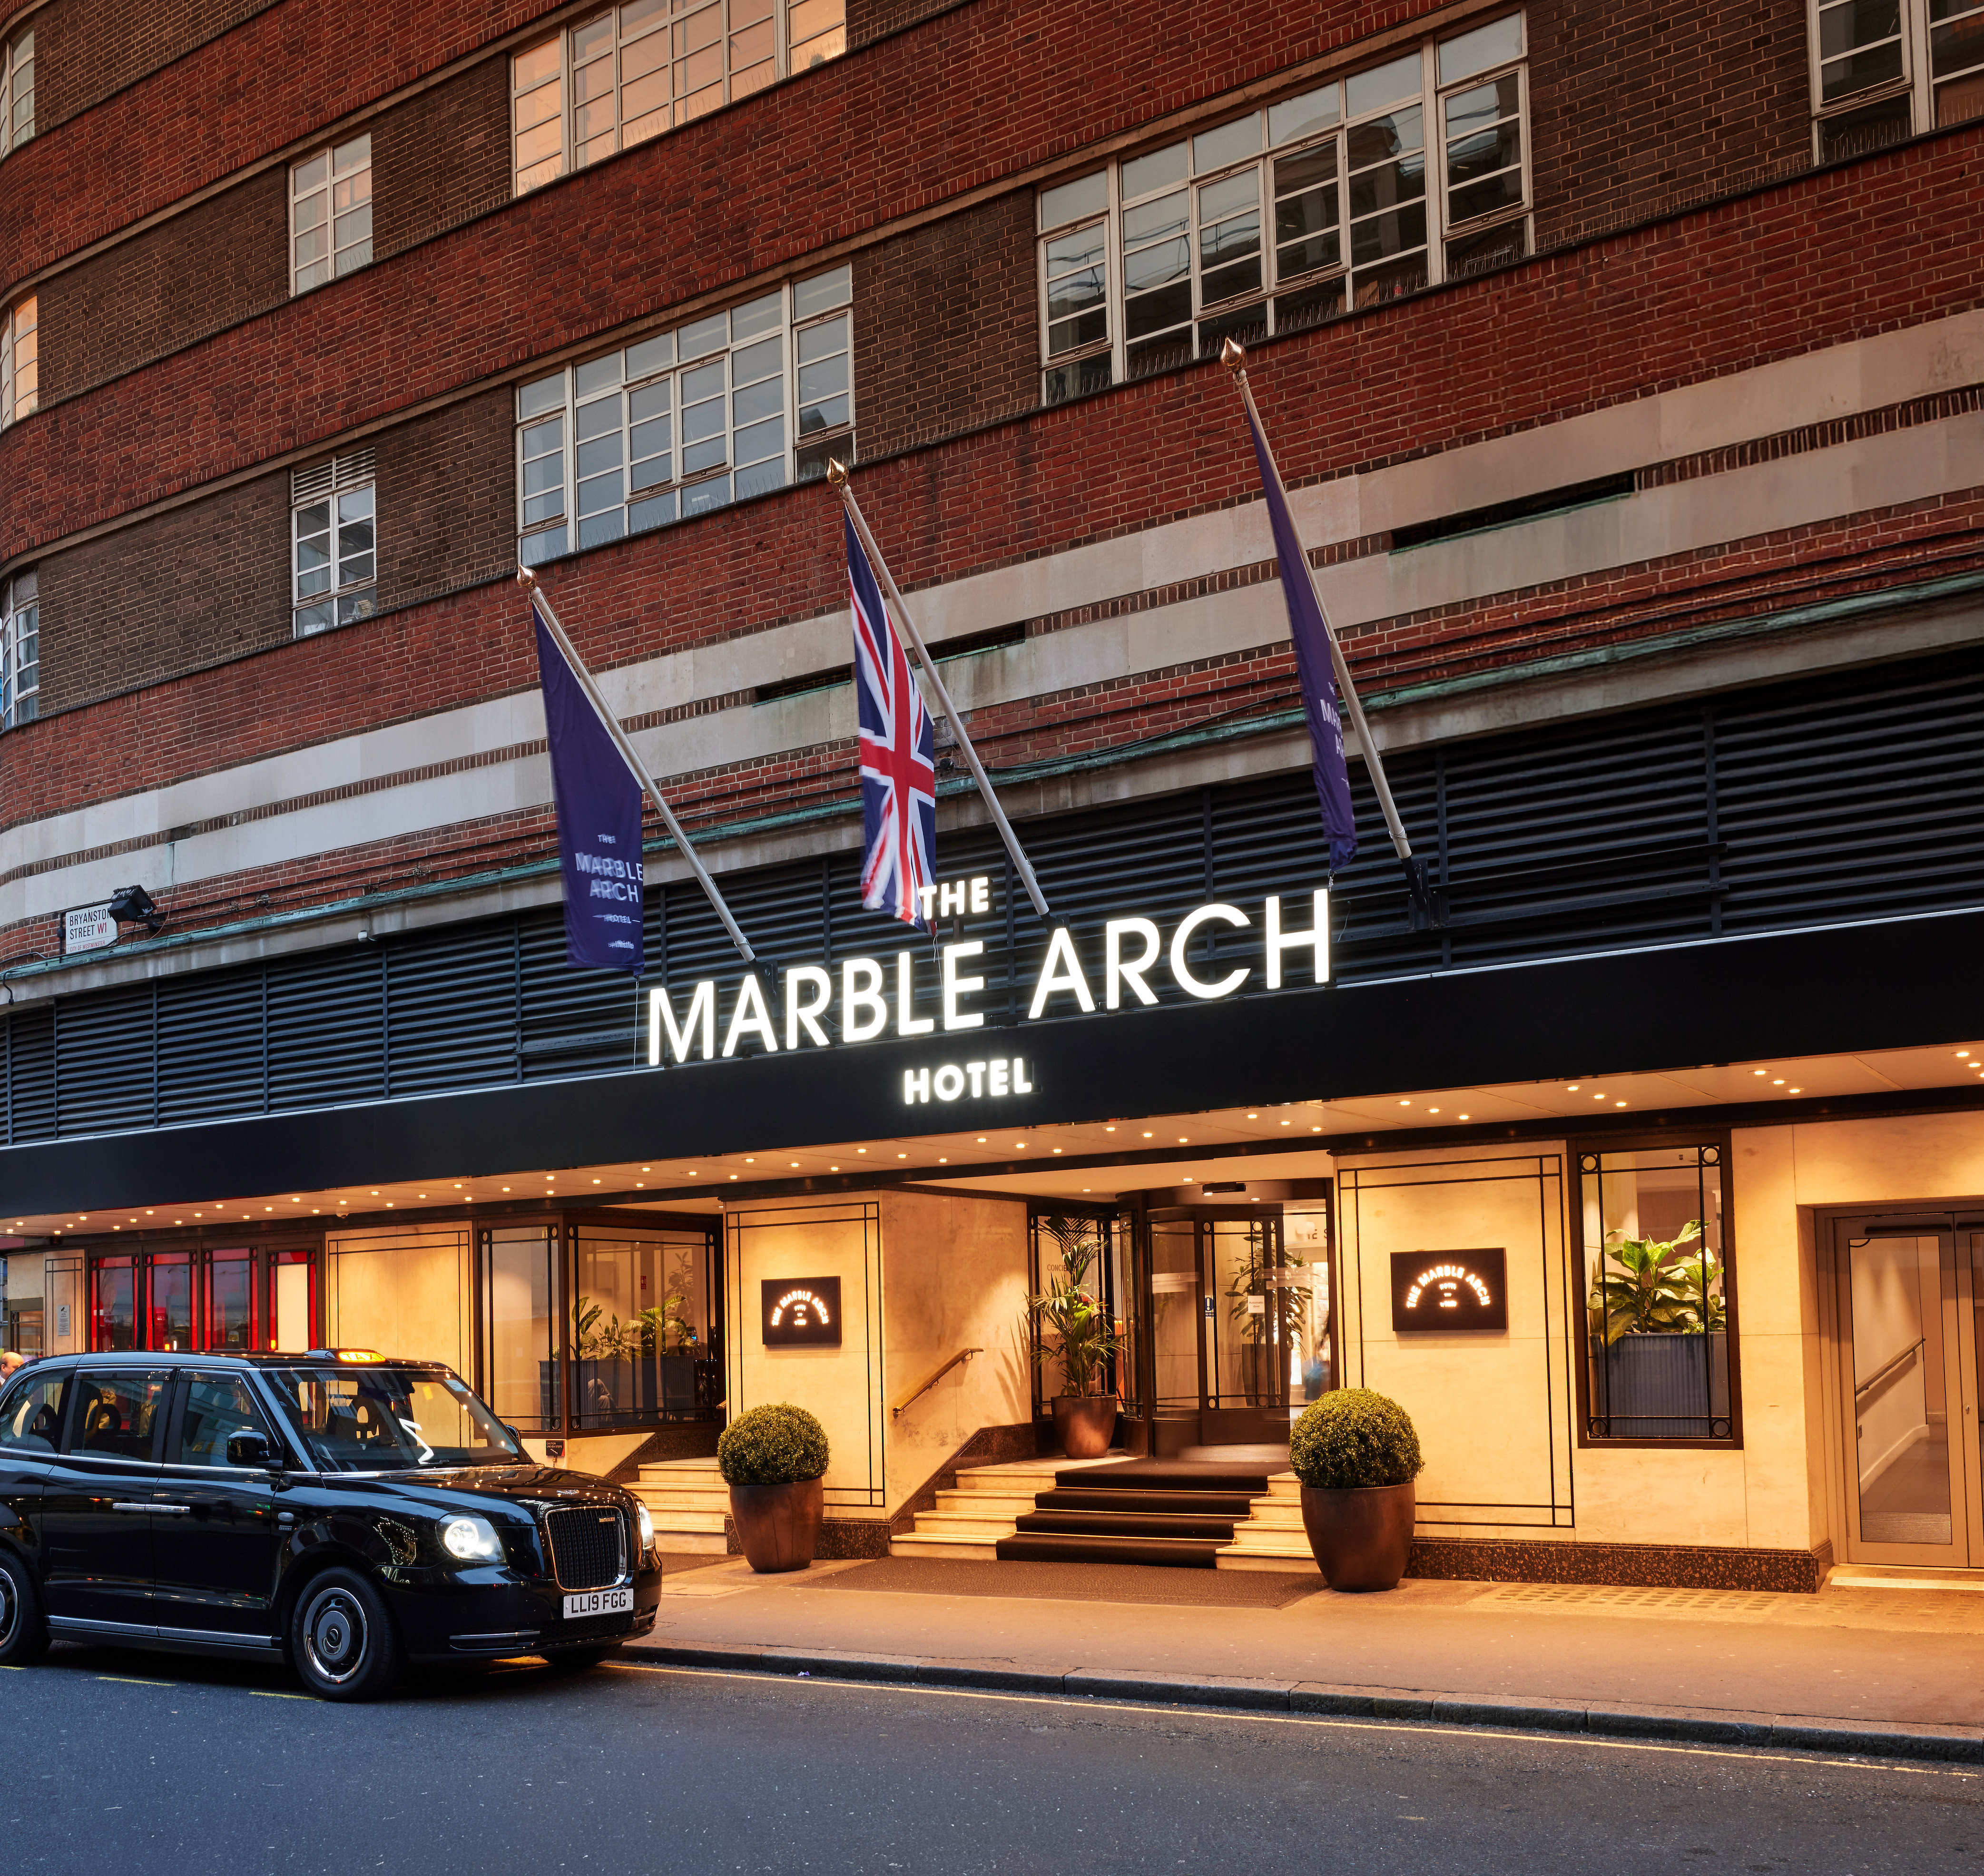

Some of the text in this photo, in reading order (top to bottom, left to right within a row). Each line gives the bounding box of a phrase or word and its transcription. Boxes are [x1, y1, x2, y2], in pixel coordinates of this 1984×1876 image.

[598, 834, 616, 844] THE
[575, 852, 643, 881] MARBLE
[590, 878, 638, 903] ARCH
[918, 876, 989, 921] THE
[70, 922, 107, 940] STREET W1
[82, 940, 105, 950] WESTMINSTER
[649, 888, 1330, 1067] MARBLE ARCH
[904, 1057, 1033, 1105] HOTEL
[1406, 1265, 1491, 1308] THE MARBLE ARCH
[772, 1290, 829, 1326] THE MARBLE ARCH
[571, 1591, 626, 1613] LL19 FGG
